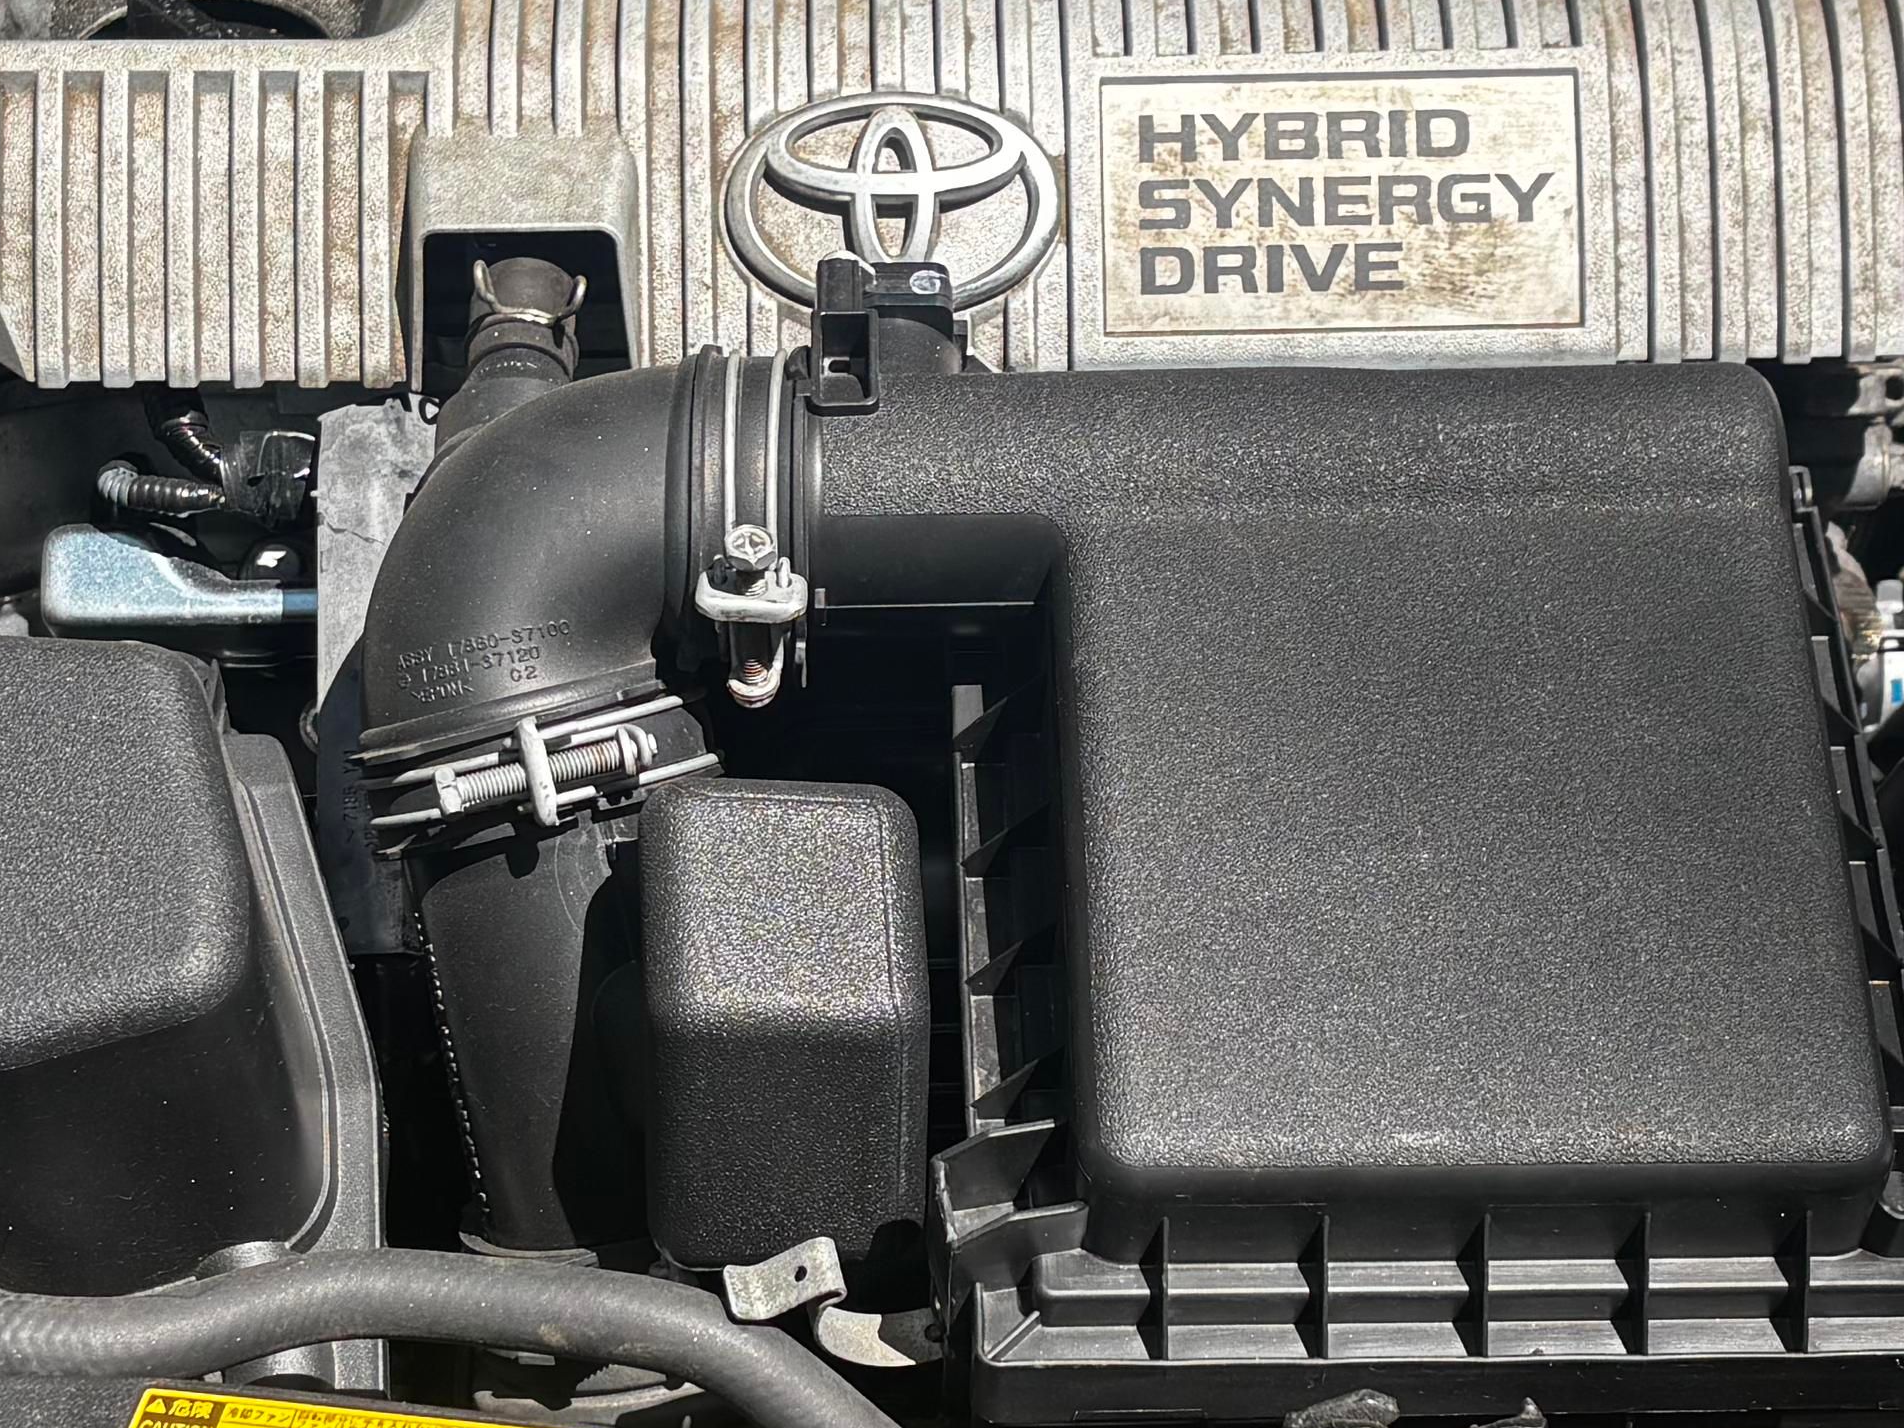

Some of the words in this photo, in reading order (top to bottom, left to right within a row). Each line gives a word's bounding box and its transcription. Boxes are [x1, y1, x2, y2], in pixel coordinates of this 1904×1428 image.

[1137, 108, 1471, 163] HYBRID
[1137, 171, 1555, 230] SYNERGY
[1138, 241, 1404, 296] DRIVE
